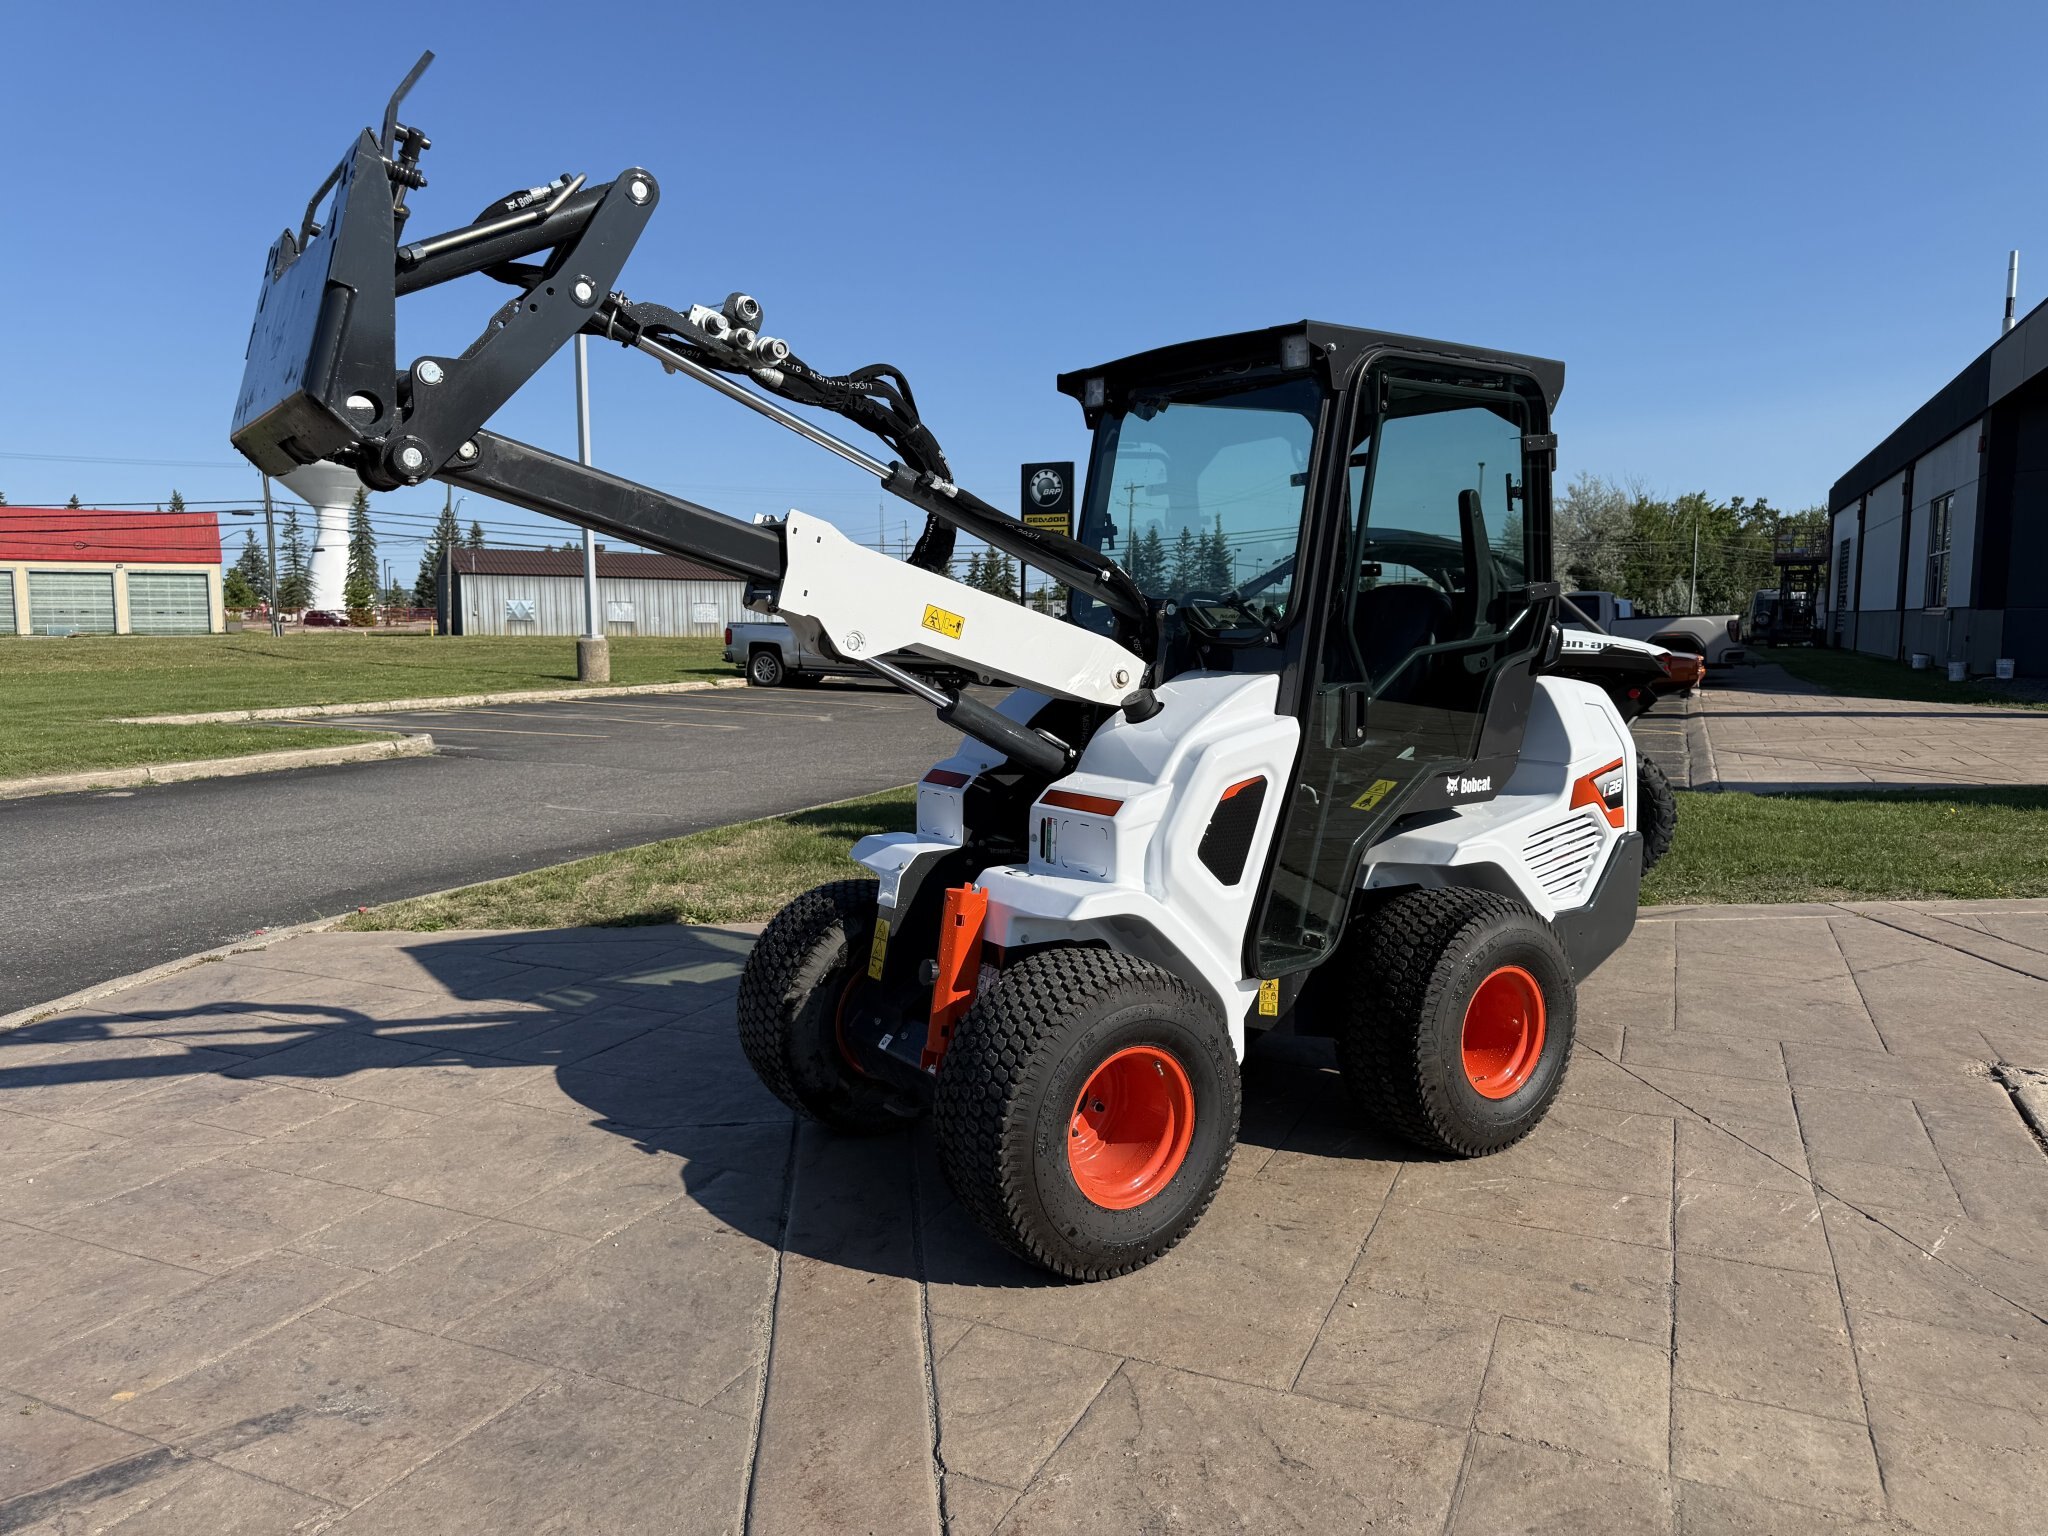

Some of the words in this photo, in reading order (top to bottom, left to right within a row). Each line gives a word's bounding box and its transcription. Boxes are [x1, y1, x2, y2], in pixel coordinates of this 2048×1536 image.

[1043, 488, 1061, 496] BRP
[1562, 640, 1611, 649] an-a
[1460, 775, 1491, 794] Bobcat
[1603, 778, 1623, 798] L28
